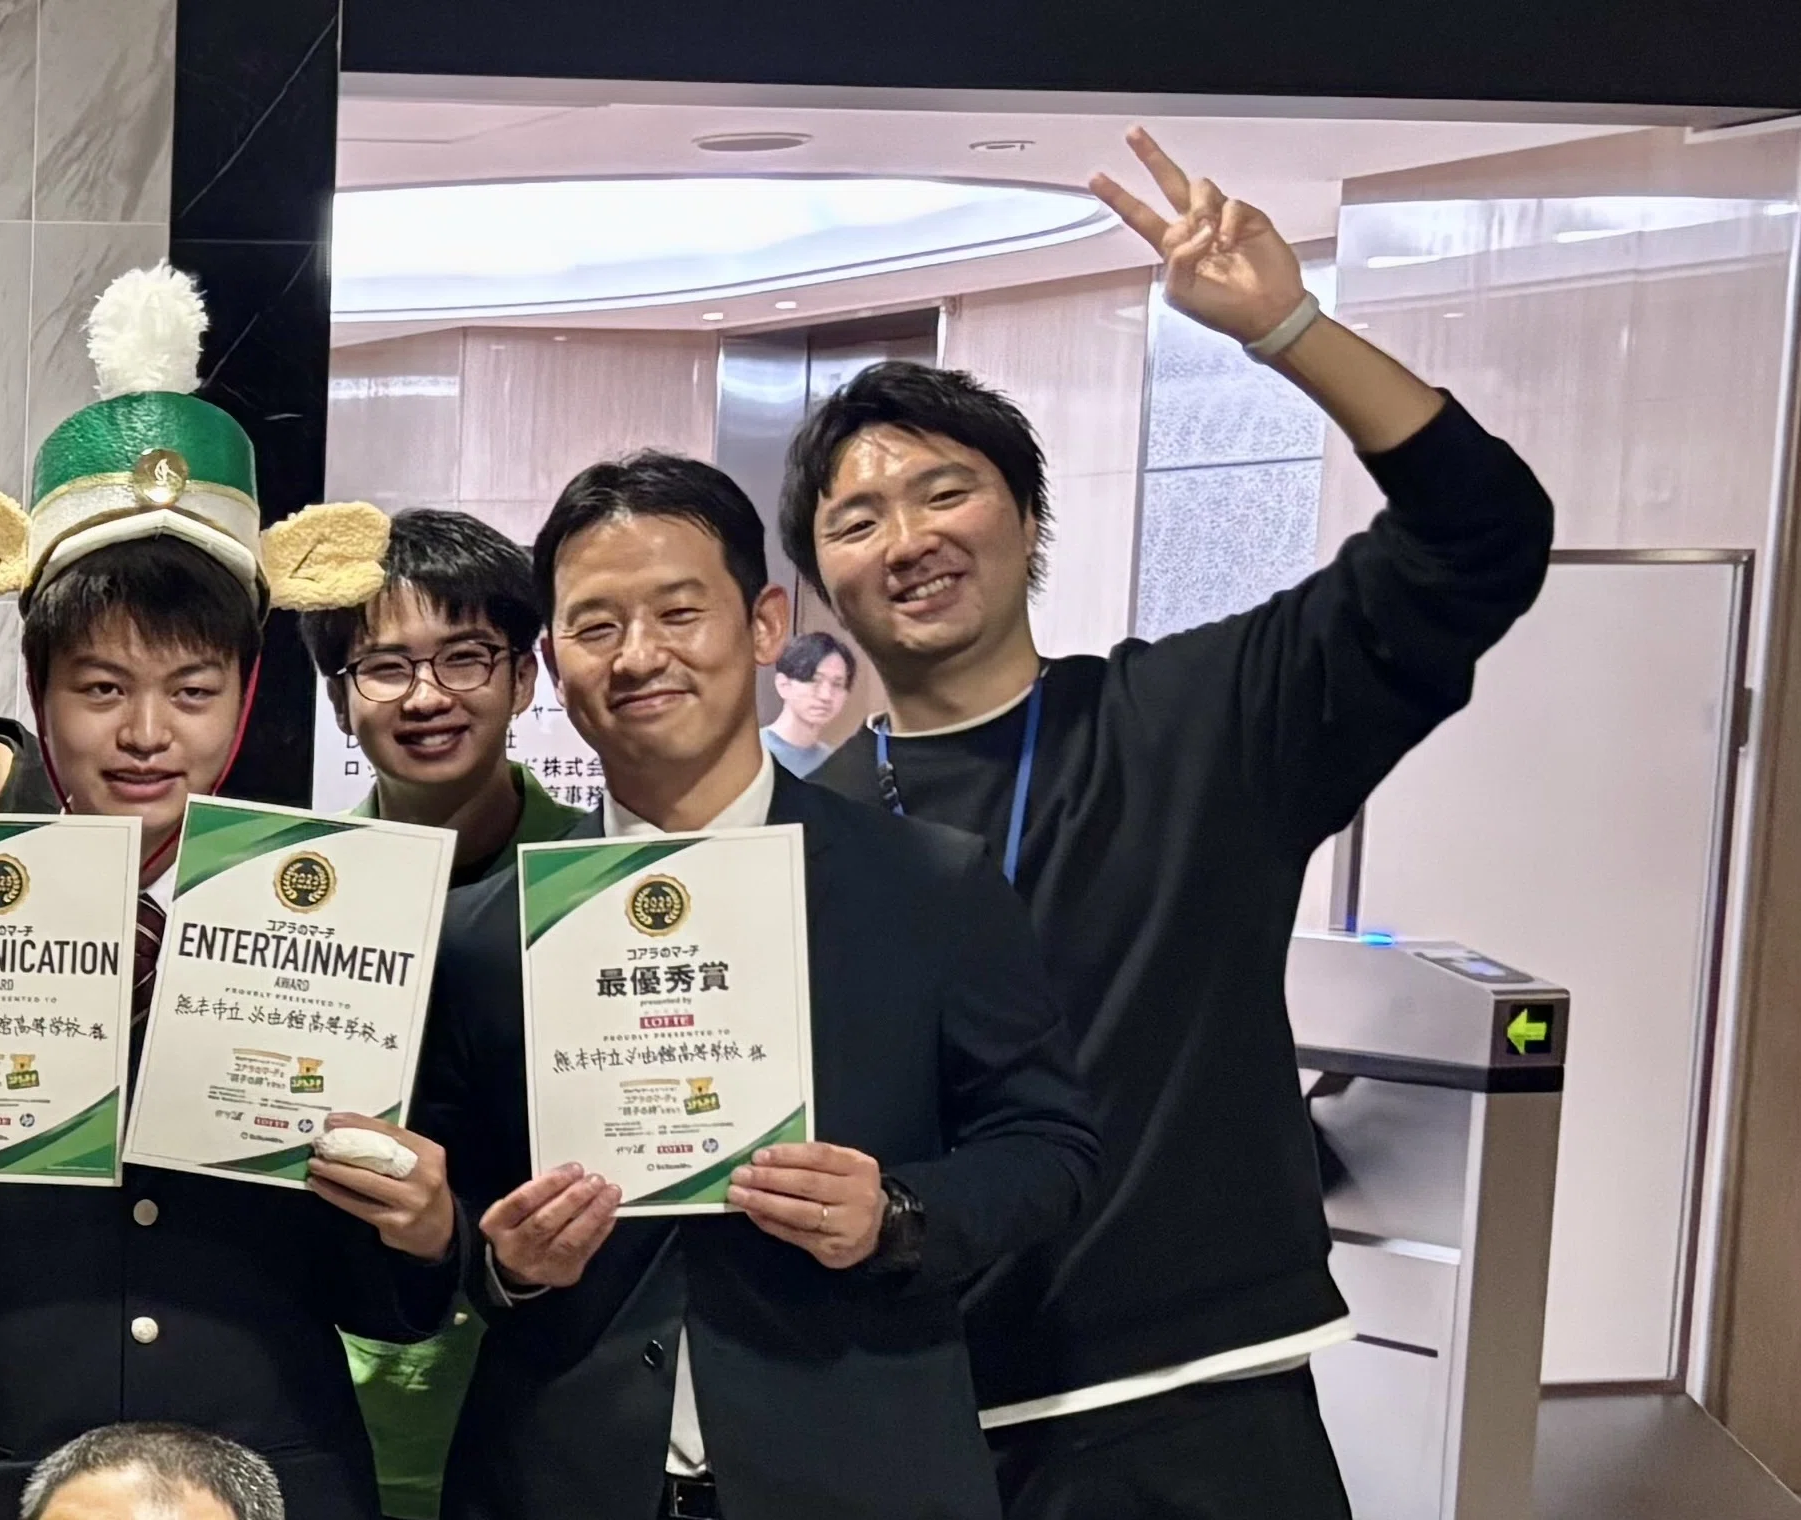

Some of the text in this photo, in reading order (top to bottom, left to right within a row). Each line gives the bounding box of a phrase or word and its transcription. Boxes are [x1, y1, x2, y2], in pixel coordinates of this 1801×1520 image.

[266, 920, 335, 939] コアラのマーチ
[178, 922, 415, 987] ENTERTAINMENT
[627, 945, 699, 961] コアラのマーチ
[274, 976, 310, 992] AWARD
[596, 961, 729, 998] 最優秀賞
[642, 1015, 691, 1028] LOTTE
